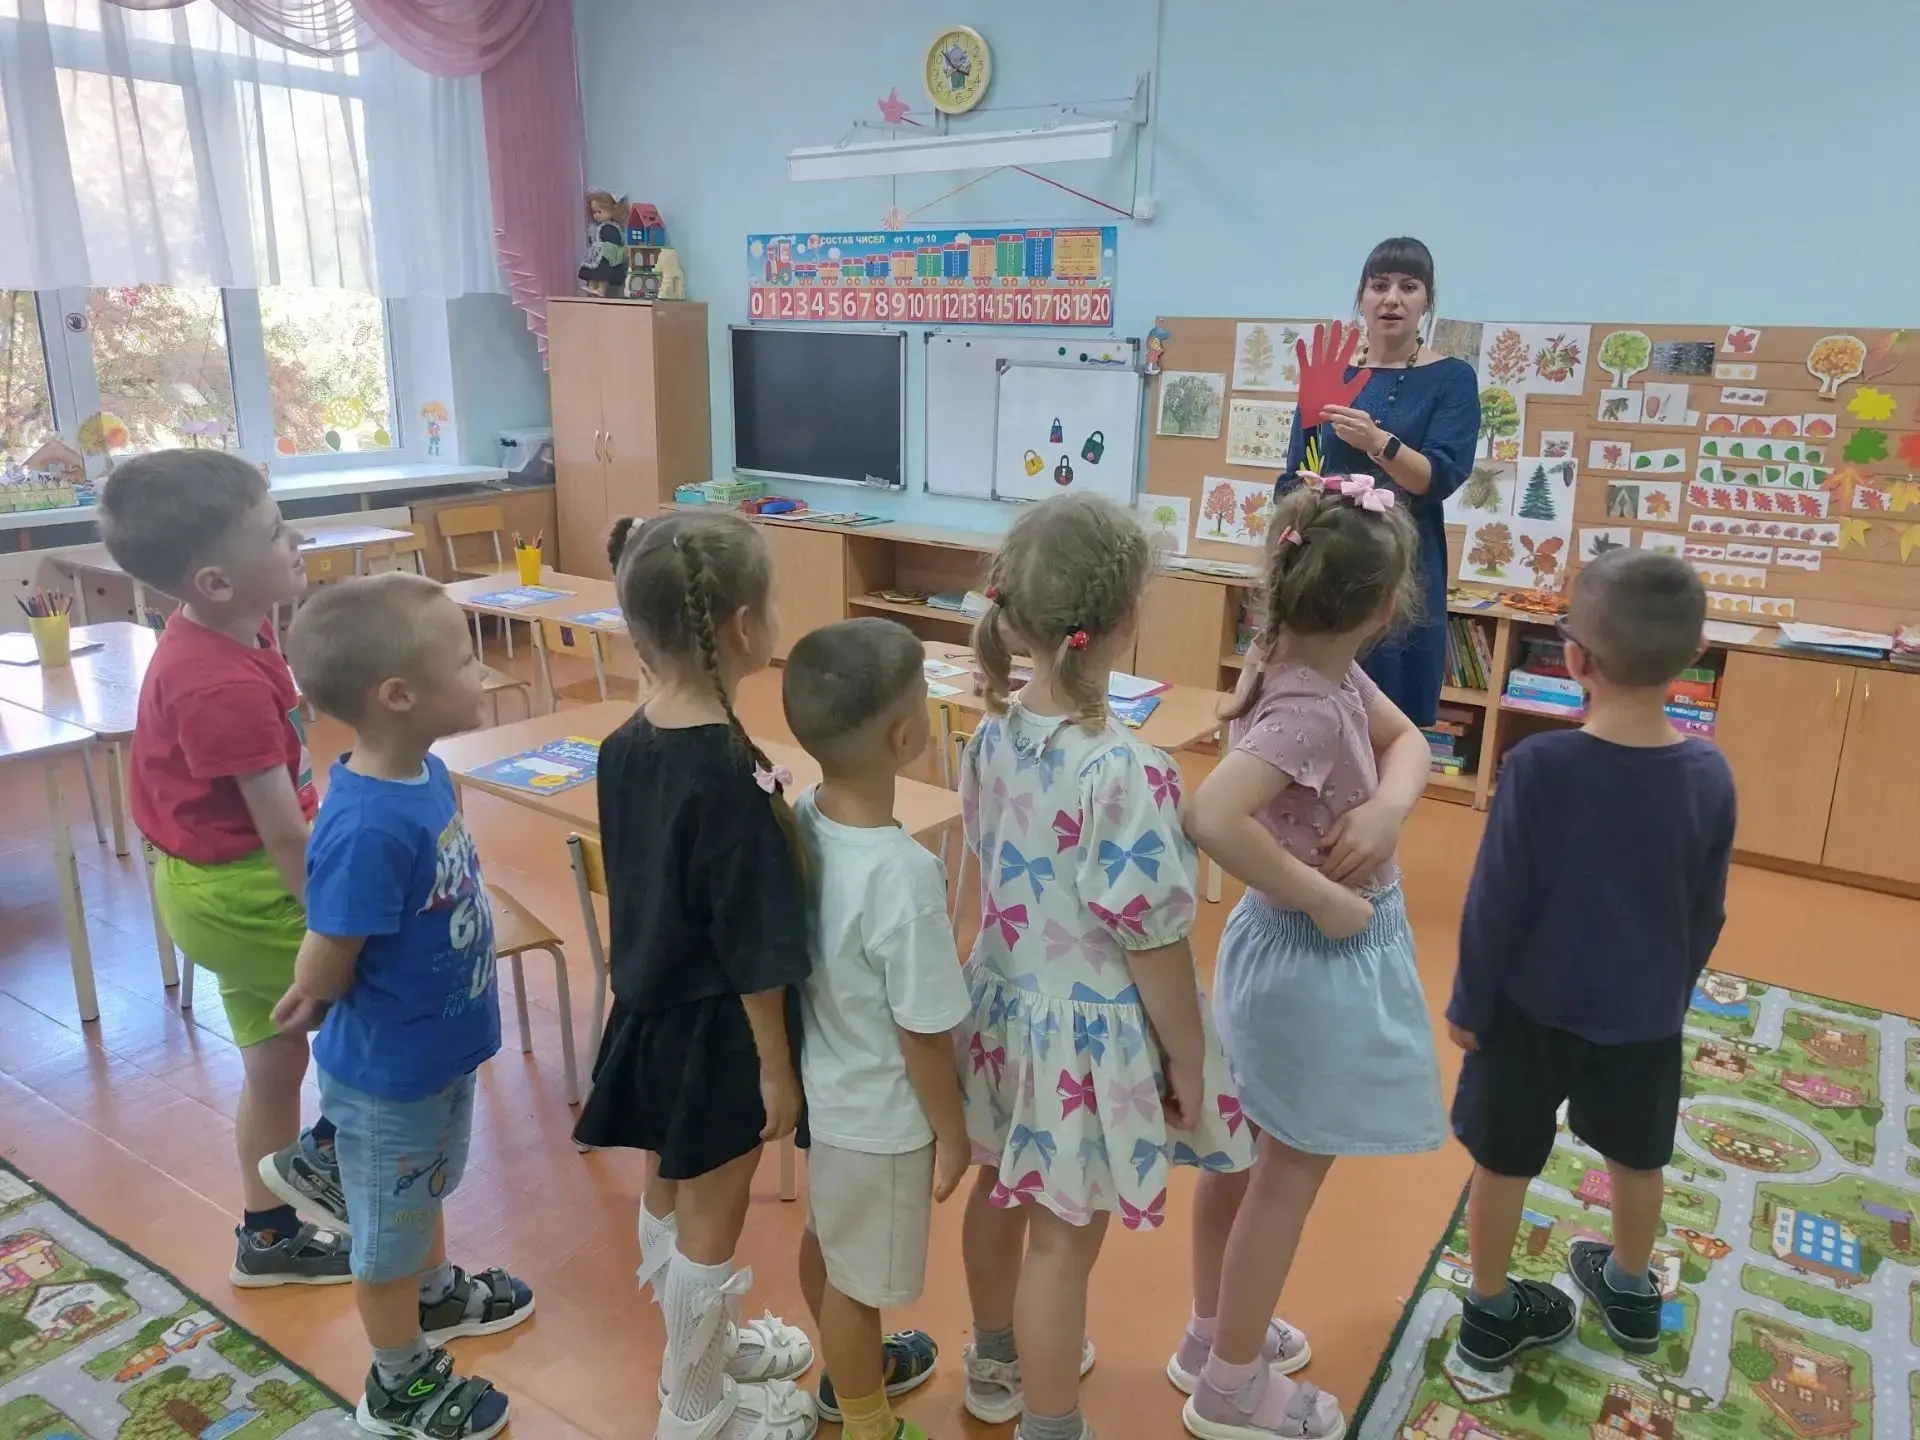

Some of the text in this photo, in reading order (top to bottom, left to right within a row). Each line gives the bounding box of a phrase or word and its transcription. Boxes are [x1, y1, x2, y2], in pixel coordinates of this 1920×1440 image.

[973, 45, 980, 58] 2
[973, 74, 981, 87] 4
[821, 234, 937, 245] СОСТАВ ЧИСЕЛ от 1 до 10
[751, 292, 1110, 321] 0 1 2 3 4 5 6 7 8 9 10 11 12 13 14 15 16 17 18 19 20
